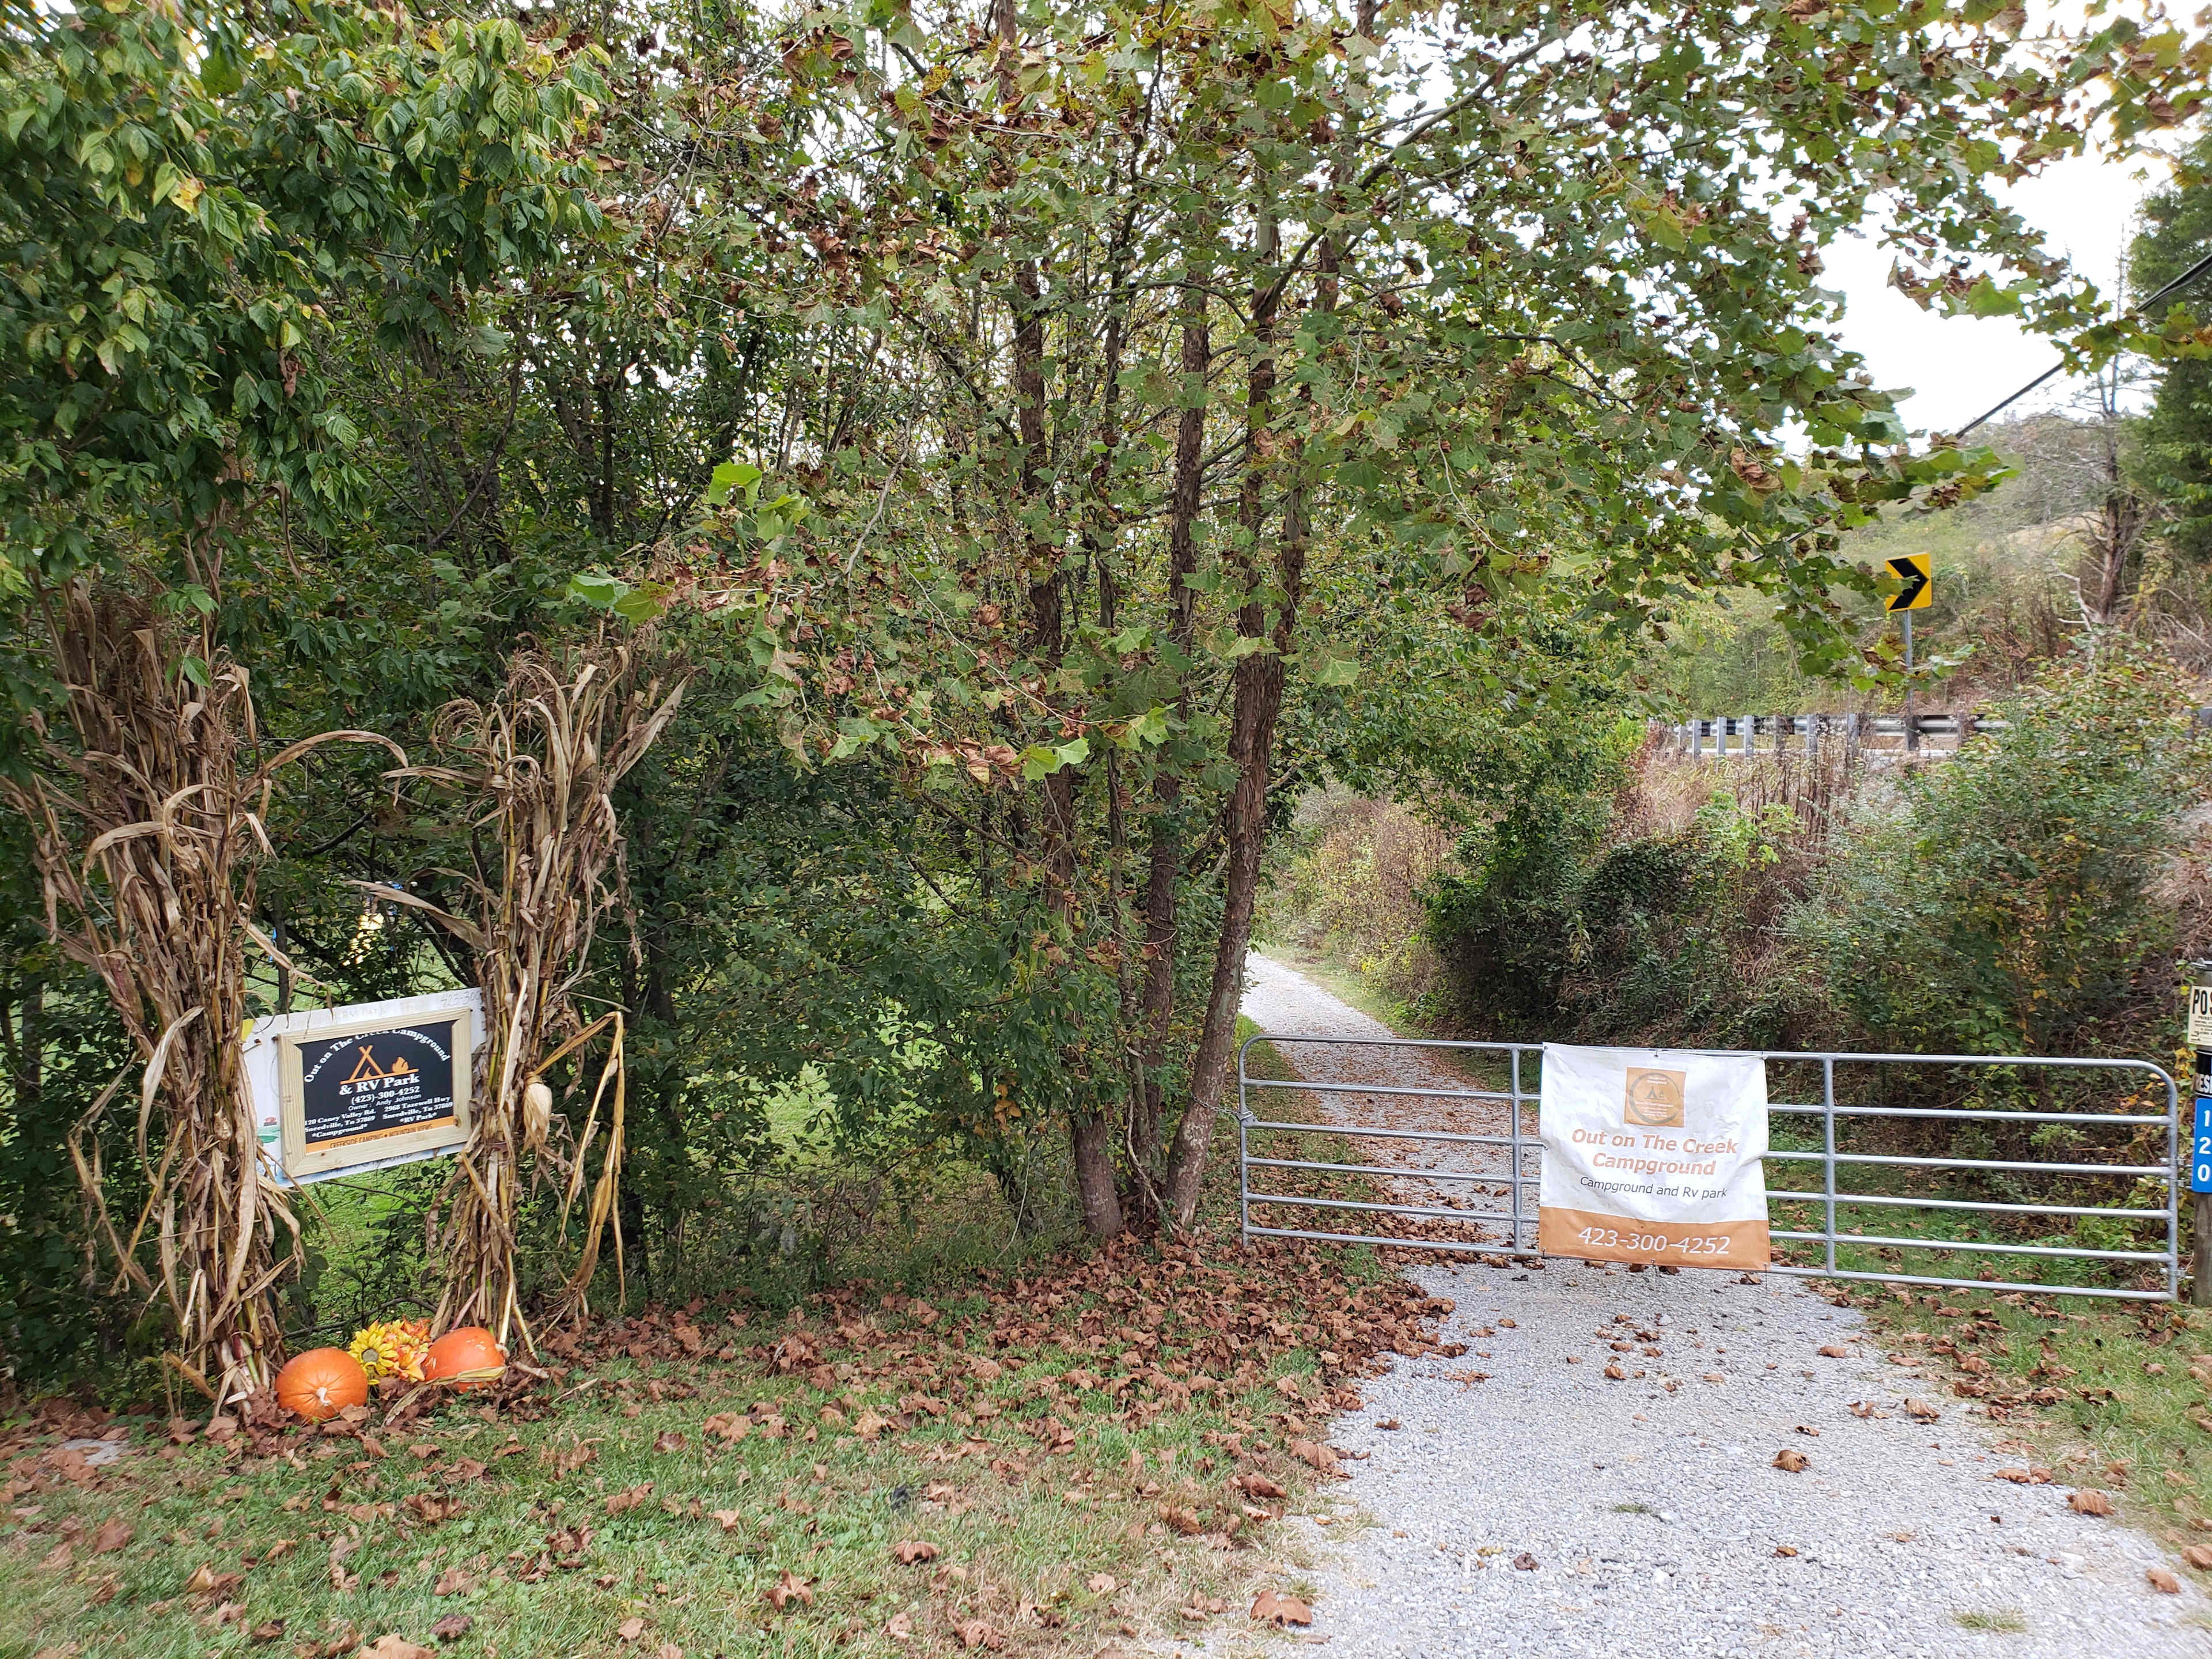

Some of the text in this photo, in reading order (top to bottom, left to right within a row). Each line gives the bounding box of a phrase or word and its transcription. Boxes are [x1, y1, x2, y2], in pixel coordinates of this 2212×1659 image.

[304, 1064, 321, 1082] Out
[320, 1052, 333, 1063] on
[329, 1038, 353, 1052] The
[392, 1029, 450, 1061] Campground
[339, 1073, 420, 1095] & RV Park
[351, 1086, 420, 1105] (423)-300-4252
[395, 1094, 421, 1103] Johnson
[402, 1099, 433, 1109] Tazewell
[1572, 1128, 1738, 1154] Out on The Creek
[1593, 1152, 1717, 1175] Campground
[1580, 1176, 1729, 1200] Campground and Rv park
[1578, 1226, 1731, 1255] 423-300-4252
